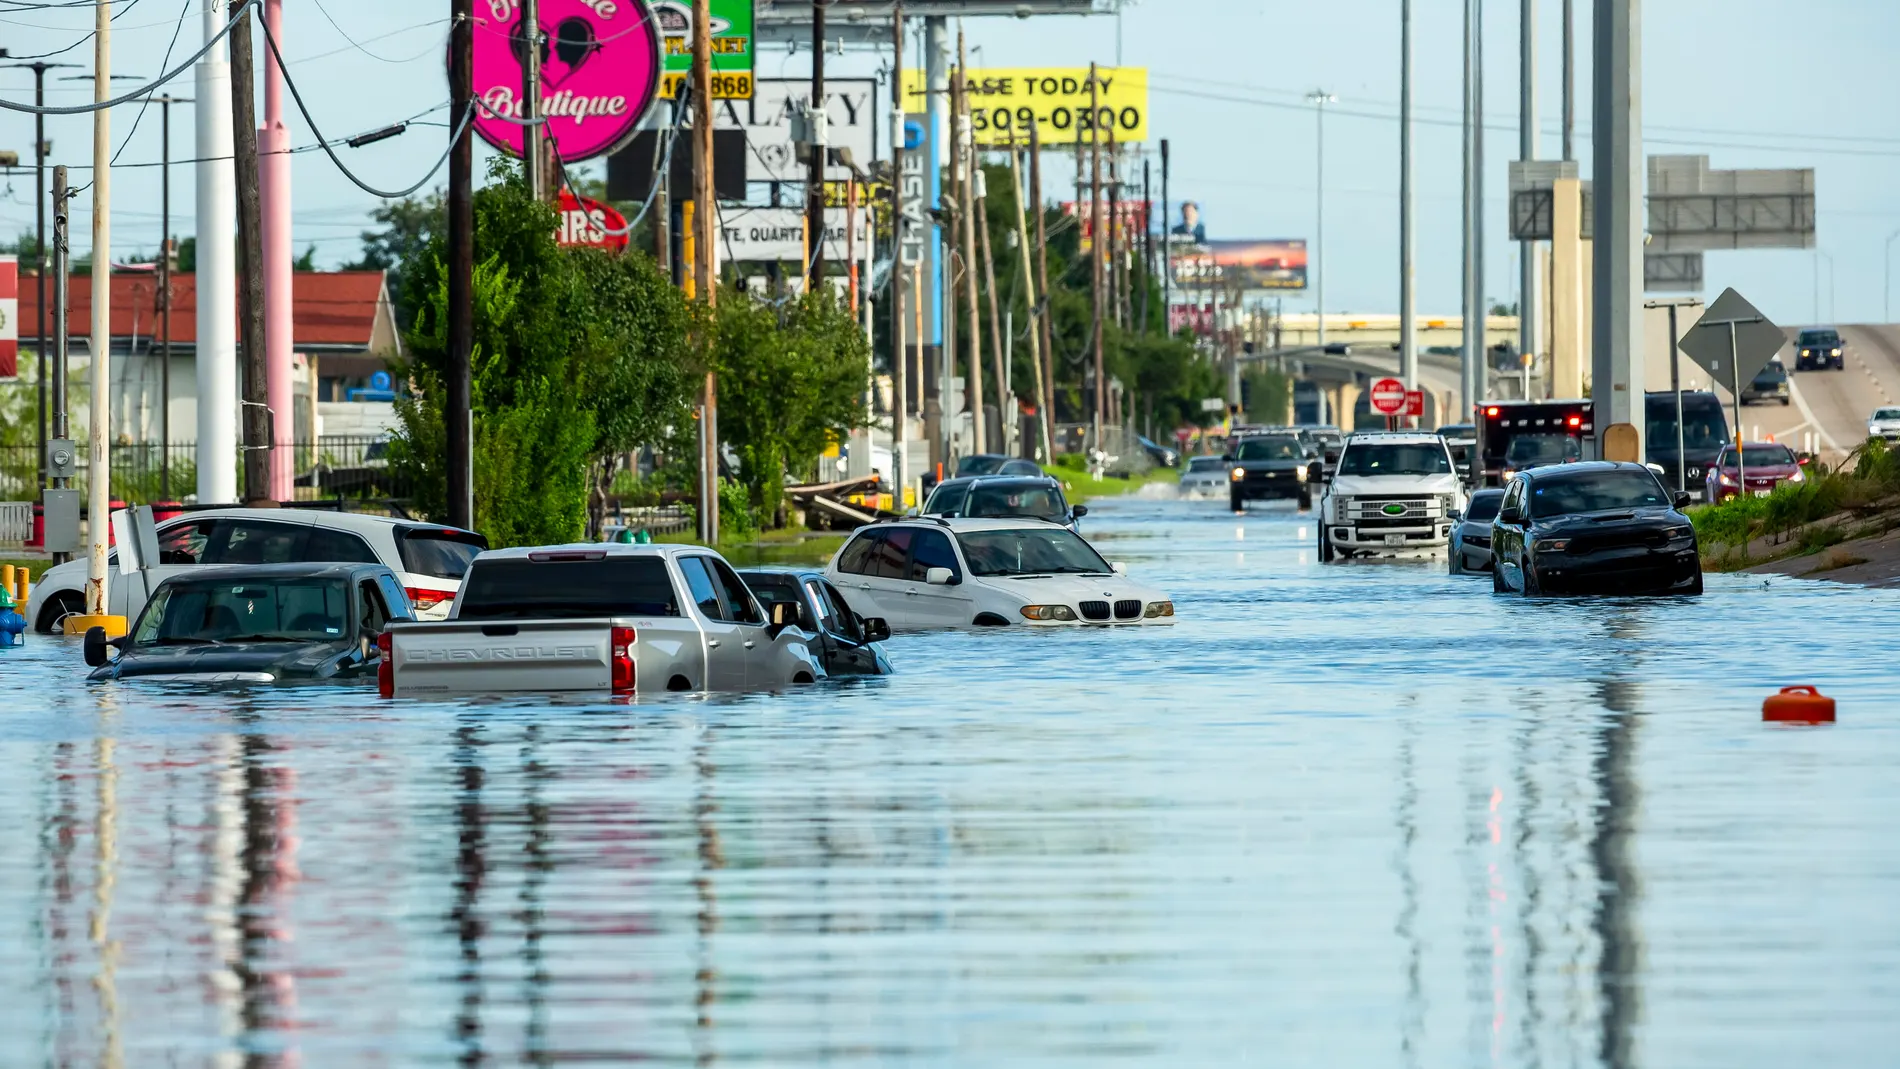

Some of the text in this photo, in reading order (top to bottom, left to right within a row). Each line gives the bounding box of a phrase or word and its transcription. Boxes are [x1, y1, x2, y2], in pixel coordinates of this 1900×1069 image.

[665, 36, 748, 54] PLNET
[1024, 78, 1112, 95] TODAY
[684, 94, 868, 127] ALAY
[901, 155, 924, 267] CHASE
[750, 227, 804, 242] QUARTZ
[406, 645, 596, 662] CHEVROLET
